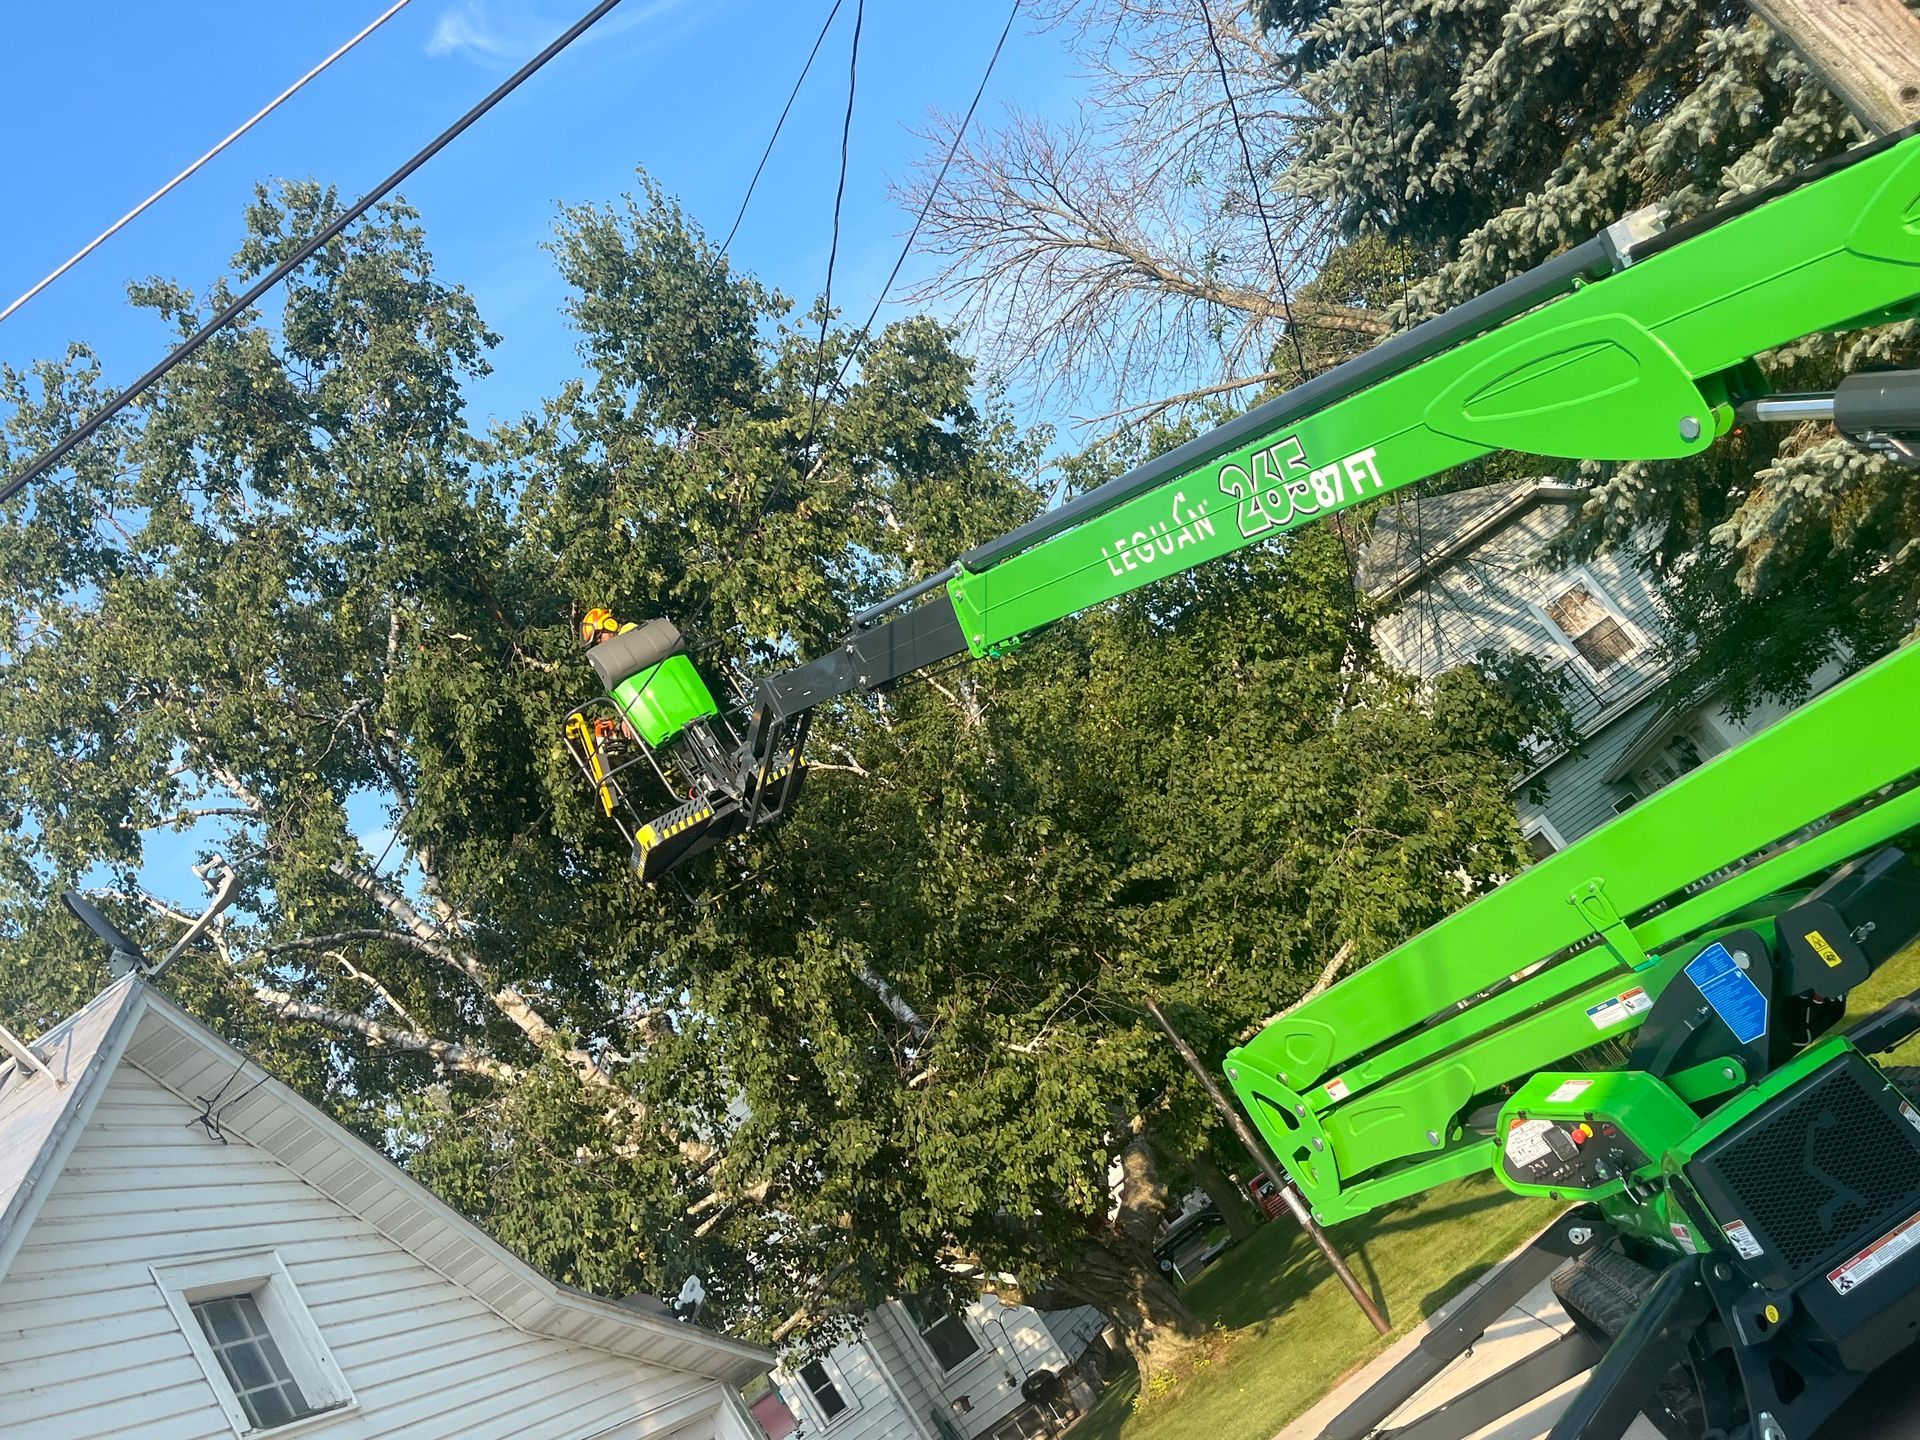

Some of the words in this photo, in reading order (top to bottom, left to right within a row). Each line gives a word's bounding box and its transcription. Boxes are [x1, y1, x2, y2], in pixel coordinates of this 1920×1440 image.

[1101, 491, 1215, 577] LEGUAN
[1218, 435, 1320, 539] 265
[1310, 464, 1346, 509] 87
[1343, 447, 1384, 496] FT
